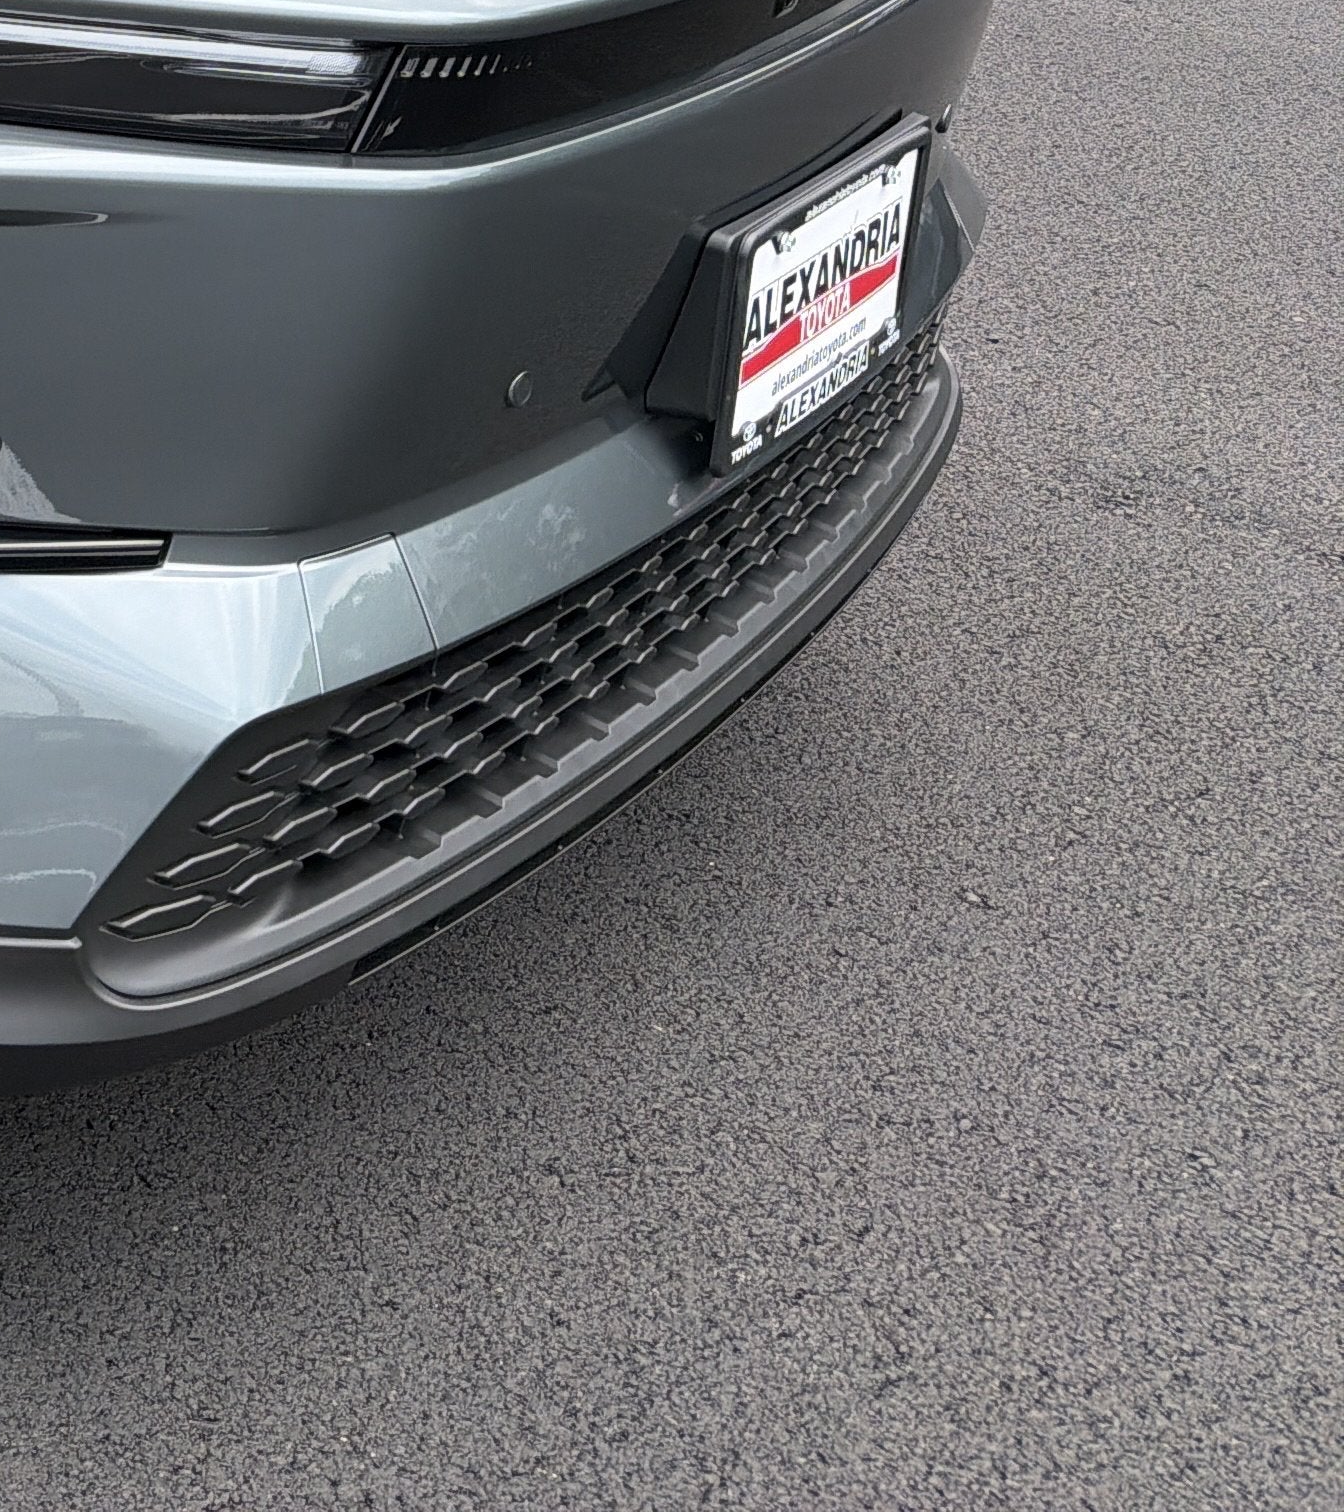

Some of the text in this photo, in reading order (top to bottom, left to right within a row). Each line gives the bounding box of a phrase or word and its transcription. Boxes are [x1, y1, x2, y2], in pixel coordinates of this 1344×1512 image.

[743, 201, 901, 350] ALEXANDRIA
[772, 317, 867, 396] alexandriatoyota.com
[799, 291, 852, 343] TOYOTA
[779, 345, 869, 427] ALEXANDRIA
[731, 434, 763, 465] TOYOTA
